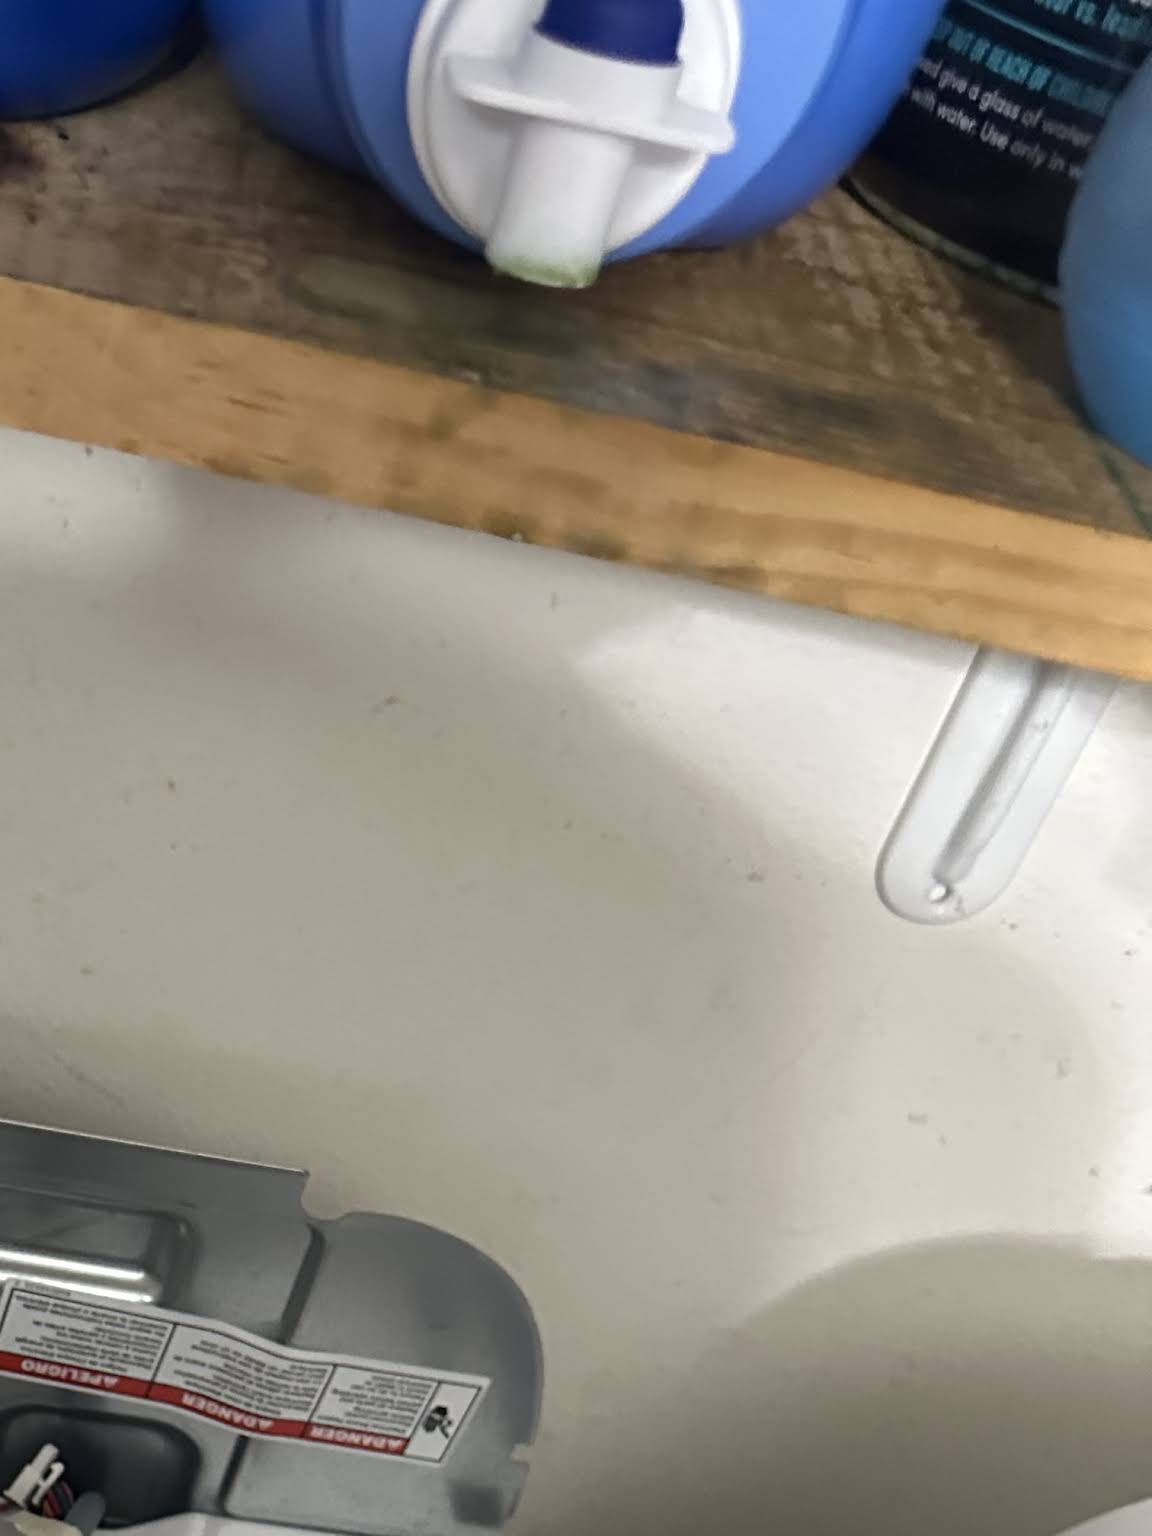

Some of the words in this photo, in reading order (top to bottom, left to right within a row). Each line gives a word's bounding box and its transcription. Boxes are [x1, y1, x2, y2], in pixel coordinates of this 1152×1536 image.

[968, 83, 980, 100] a
[979, 90, 1020, 120] glass
[1022, 107, 1043, 127] of
[980, 121, 1008, 150] Use
[1010, 140, 1045, 168] only
[1048, 154, 1065, 171] in
[19, 1357, 104, 1387] PELIGRO
[308, 1424, 387, 1449] DANGER
